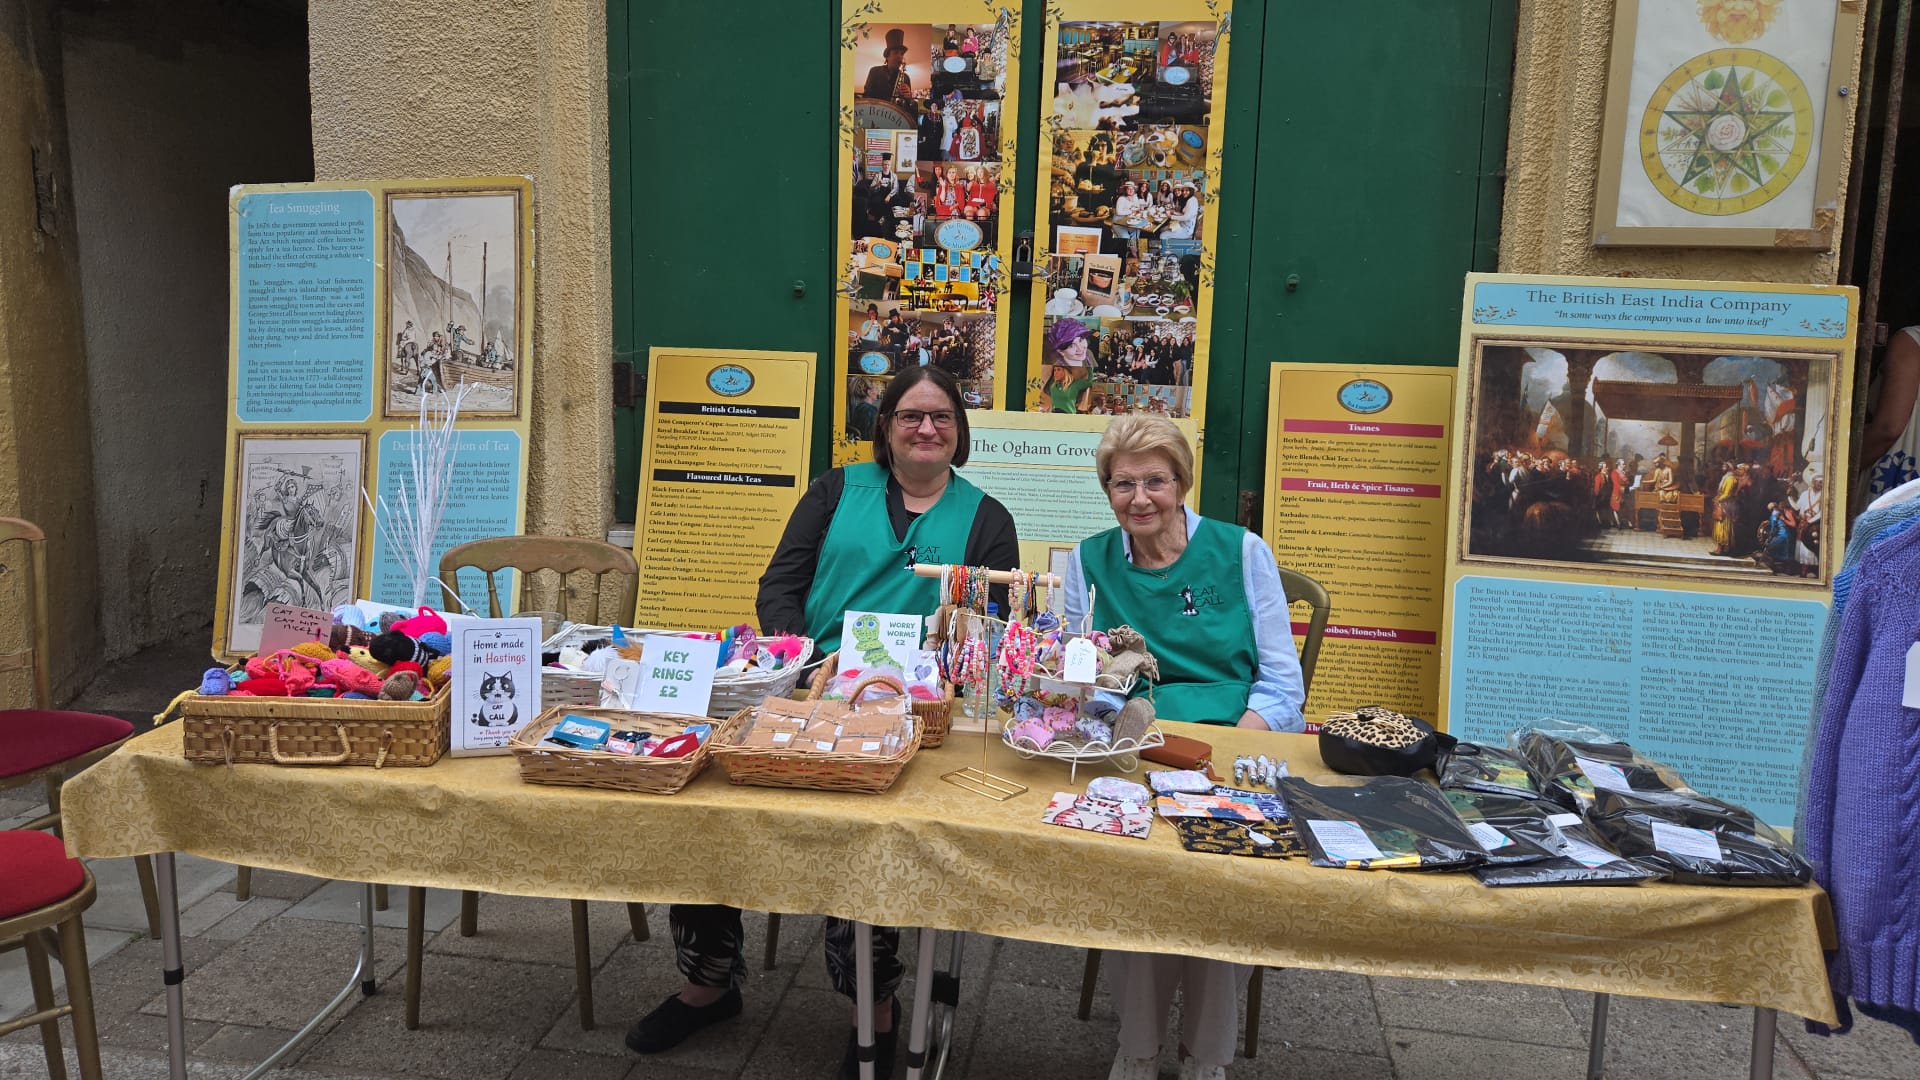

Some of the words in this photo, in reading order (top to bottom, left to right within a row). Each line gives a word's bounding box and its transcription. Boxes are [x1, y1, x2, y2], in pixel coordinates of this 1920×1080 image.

[269, 203, 284, 213] Tea
[287, 202, 340, 215] Smuggling
[1526, 290, 1557, 303] The
[1562, 291, 1615, 305] British
[1621, 294, 1656, 306] East
[1662, 296, 1704, 308] India
[1710, 297, 1792, 315] Company
[1594, 314, 1616, 322] ways
[1618, 312, 1632, 320] the
[1634, 316, 1674, 325] company
[1706, 315, 1721, 324] law
[701, 405, 725, 413] British
[727, 406, 756, 414] Classics
[479, 440, 489, 450] of
[491, 440, 509, 450] Tea
[972, 440, 998, 453] The
[1003, 441, 1052, 458] Ogham
[1056, 444, 1096, 456] Grove
[673, 459, 704, 467] Champagne
[686, 473, 721, 481] Flavoured
[723, 474, 743, 482] Black
[745, 475, 761, 483] Teas
[1307, 480, 1328, 489] Fruit,
[1361, 483, 1381, 492] Spice
[1383, 484, 1414, 492] Tisanes
[917, 546, 941, 554] CAT
[916, 554, 942, 563] CALL
[1192, 586, 1215, 597] CAT
[1194, 596, 1224, 607] CALL
[1669, 602, 1687, 610] USA,
[1691, 604, 1714, 612] spices
[1743, 608, 1785, 617] Caribbean,
[887, 630, 916, 638] WORMS
[1324, 626, 1396, 638] oibos/Honeybush
[474, 640, 498, 650] Home
[501, 639, 524, 648] made
[474, 655, 482, 664] in
[486, 653, 526, 664] Hastings
[664, 650, 689, 664] KEY
[652, 667, 694, 682] RINGS
[660, 686, 678, 698] £2
